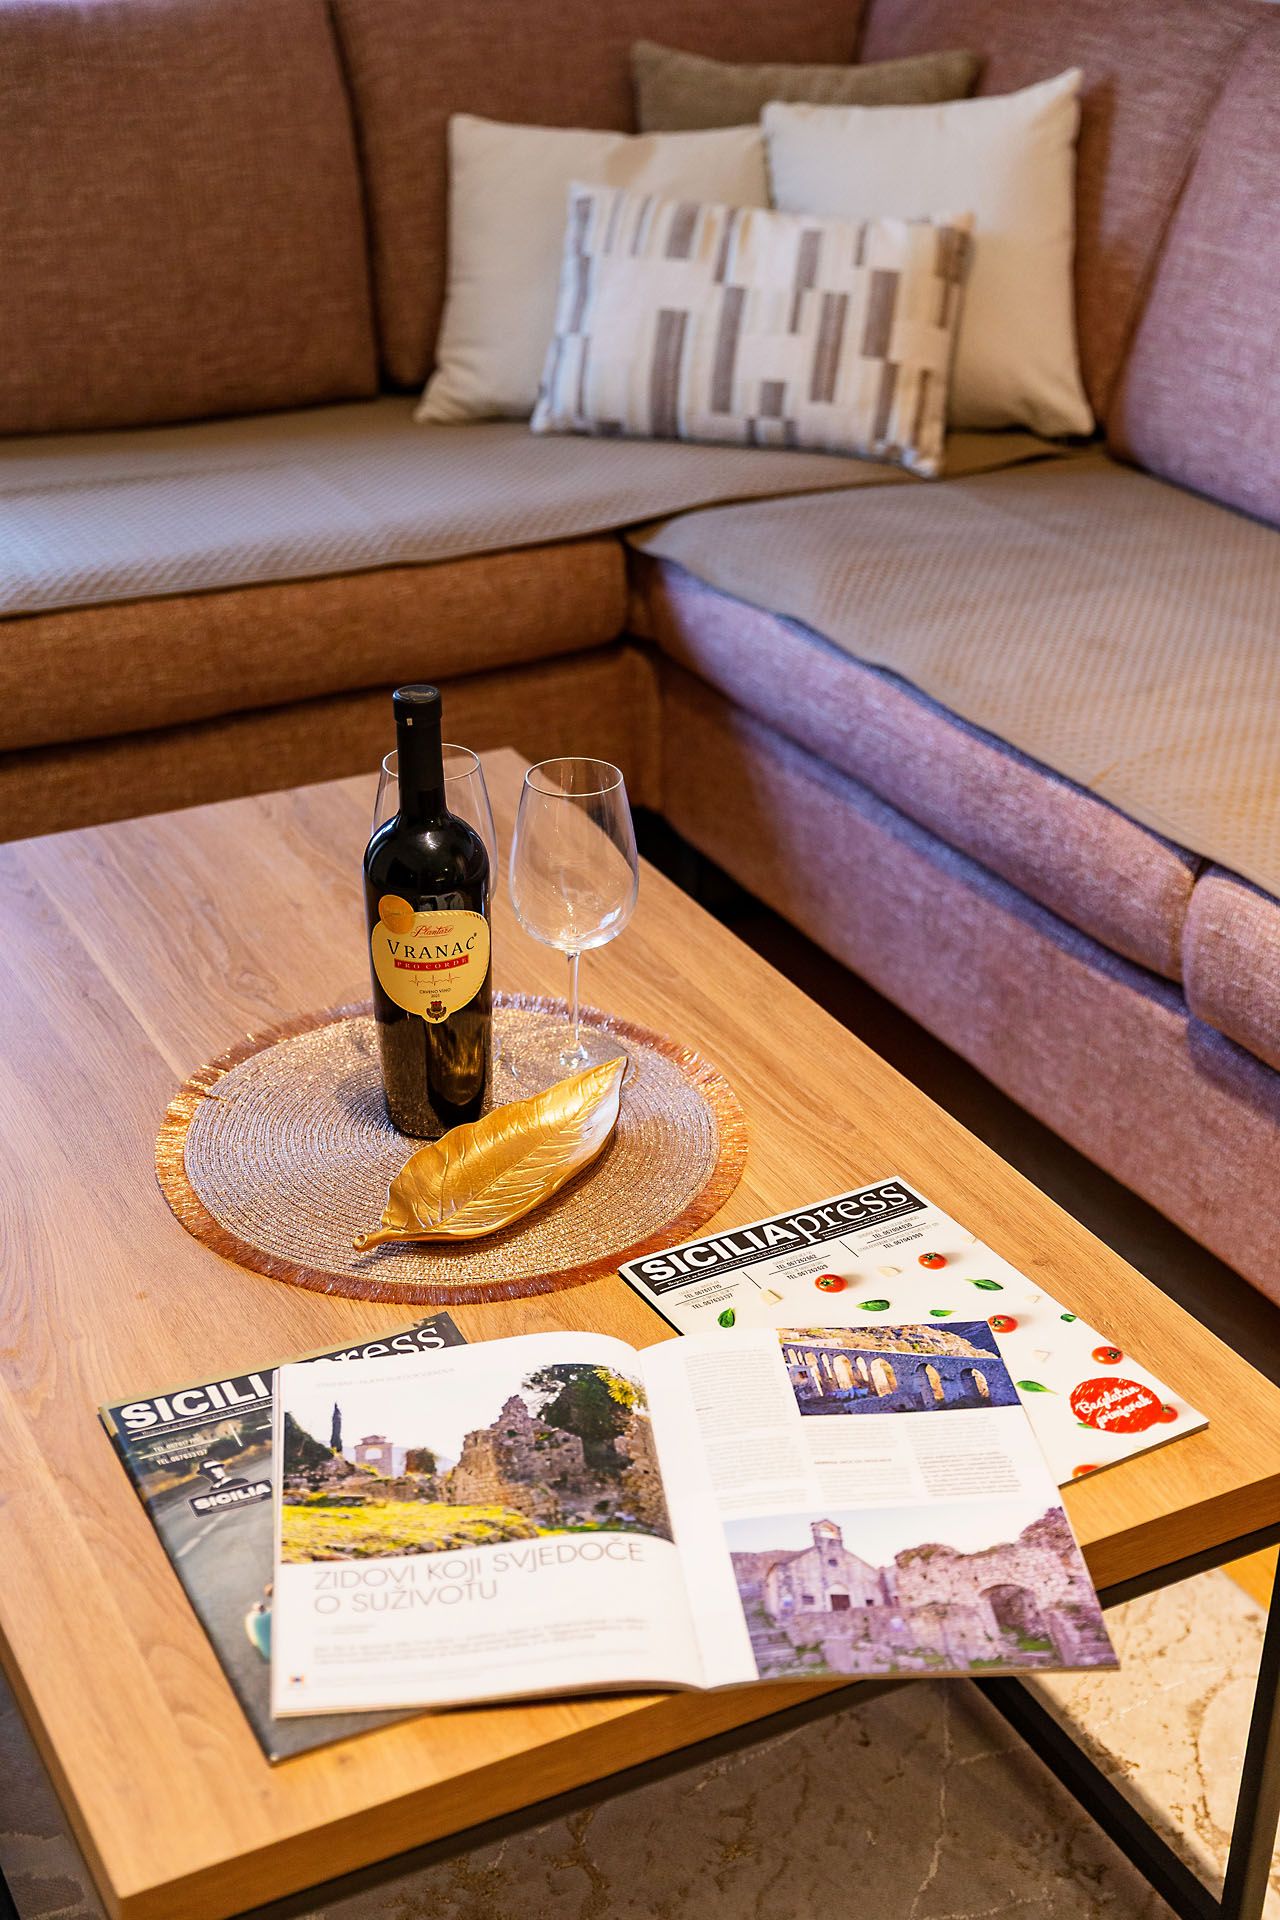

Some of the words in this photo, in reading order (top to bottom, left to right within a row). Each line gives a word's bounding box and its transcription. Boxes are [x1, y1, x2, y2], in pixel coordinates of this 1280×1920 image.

[397, 961, 420, 969] PRO
[425, 958, 467, 970] CORDE
[1075, 1386, 1140, 1414] Besplatan
[194, 1483, 271, 1510] SICILIA
[314, 1565, 416, 1591] ZIDOVI
[427, 1557, 482, 1583] KOJI
[494, 1538, 646, 1573] SVJEDOČE
[314, 1594, 341, 1615] O
[352, 1580, 498, 1613] SUŽIVOTU
